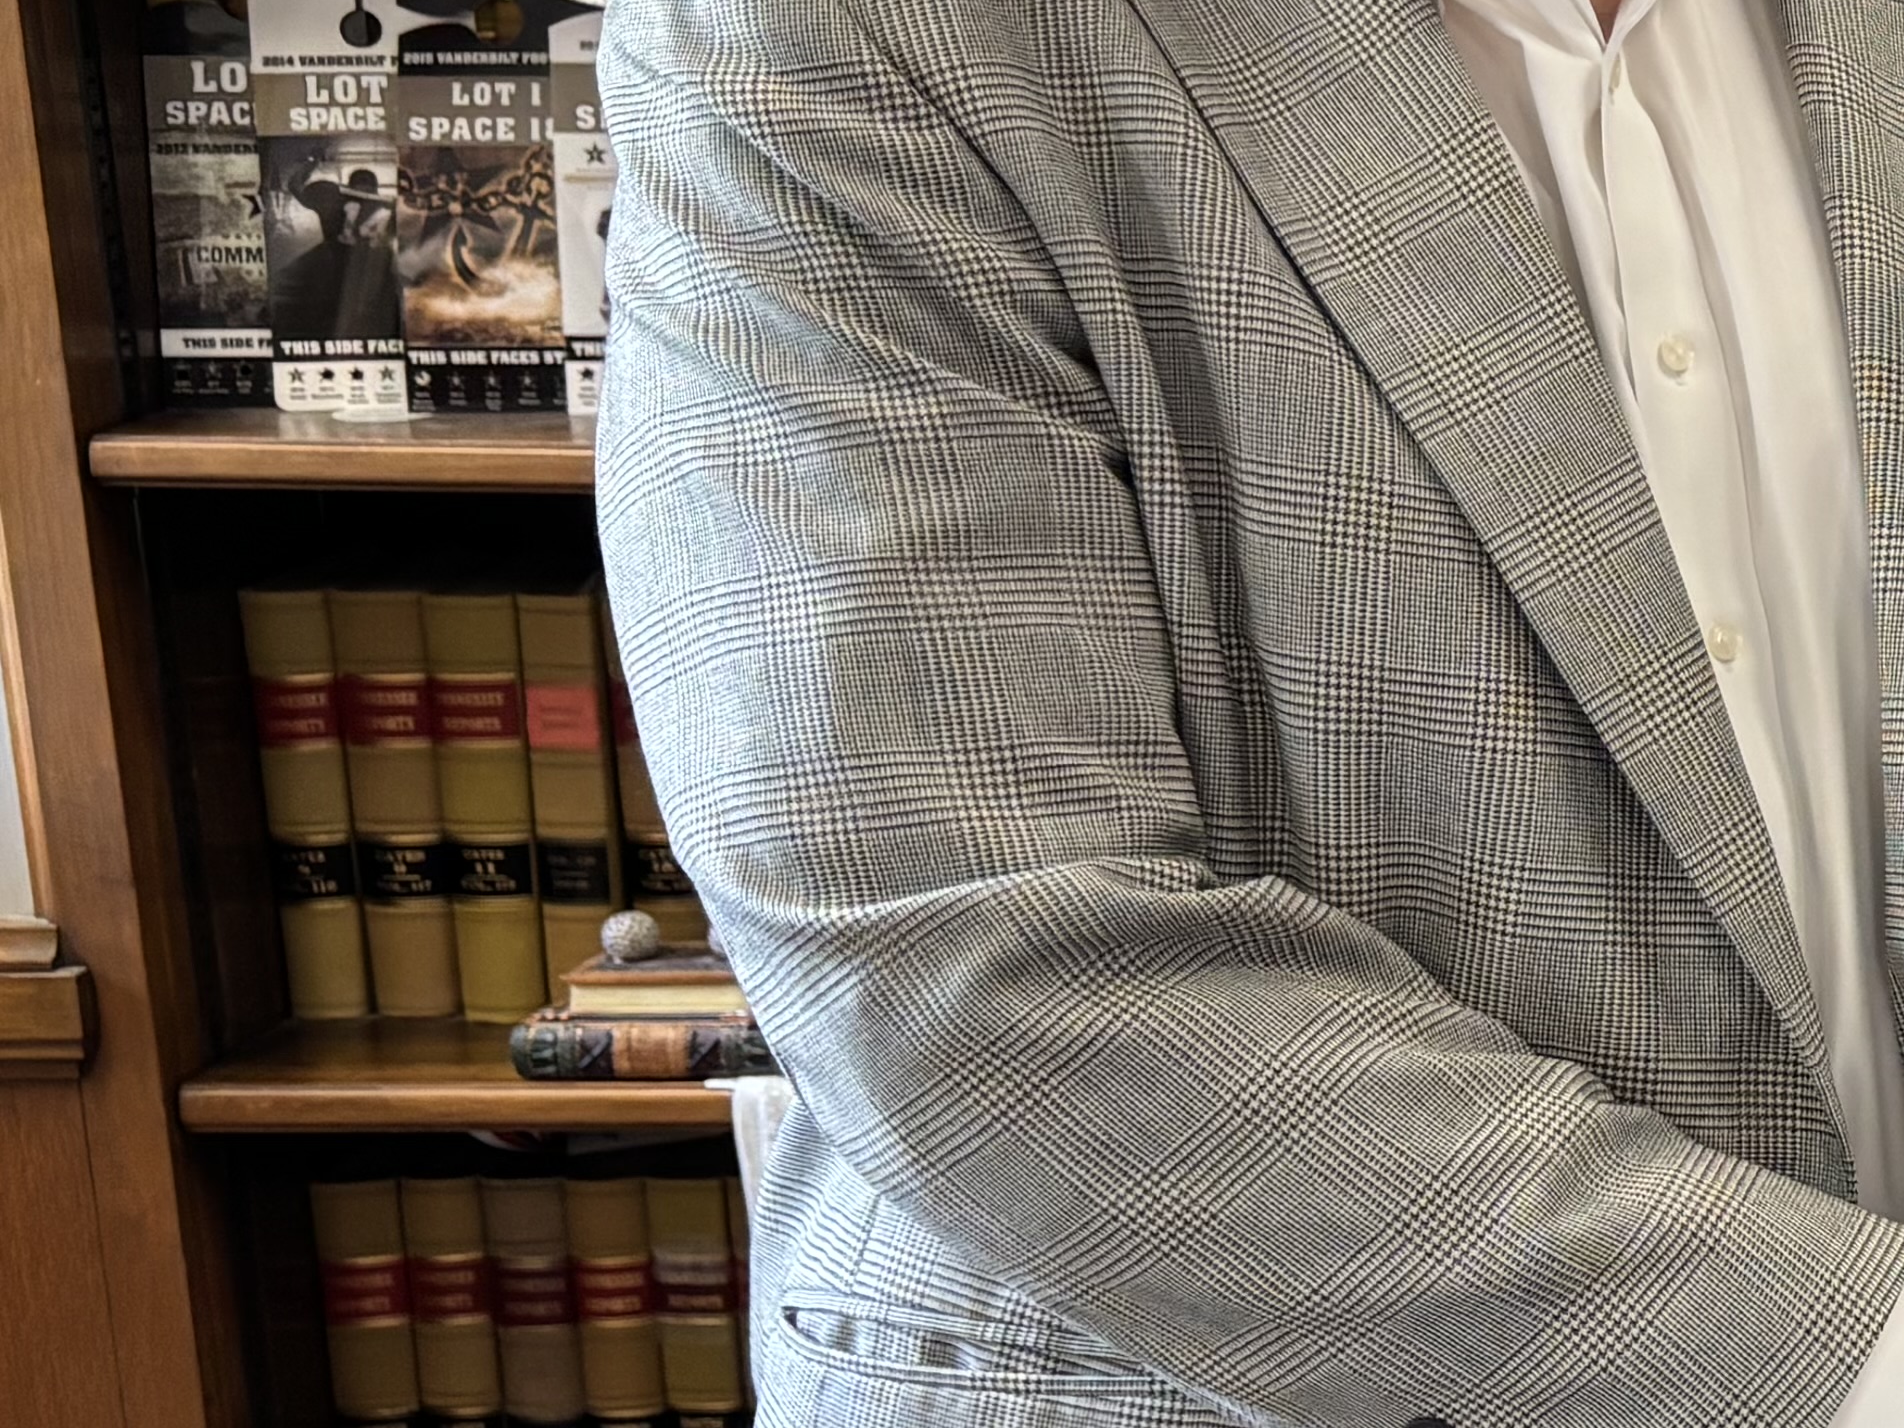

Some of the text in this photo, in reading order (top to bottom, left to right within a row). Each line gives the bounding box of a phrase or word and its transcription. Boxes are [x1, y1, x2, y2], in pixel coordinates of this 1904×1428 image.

[299, 56, 387, 67] VANDERBILT
[437, 52, 519, 65] VANDERBILT
[305, 75, 387, 104] LOT
[452, 82, 515, 106] LOT
[289, 107, 386, 131] SPACE
[408, 118, 515, 141] SPACE
[281, 341, 363, 355] THIS SIDE
[408, 352, 447, 364] THIS
